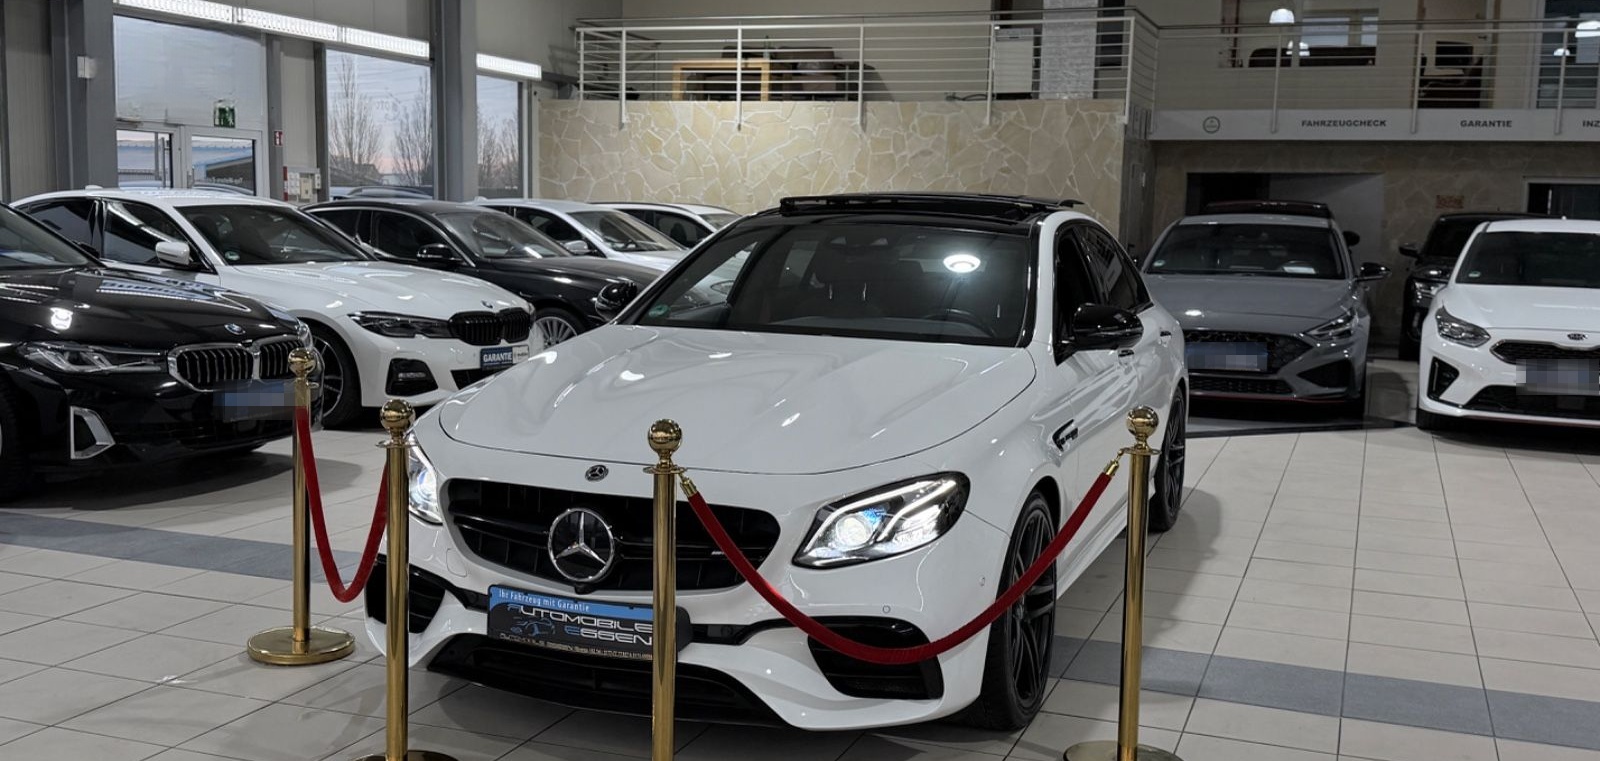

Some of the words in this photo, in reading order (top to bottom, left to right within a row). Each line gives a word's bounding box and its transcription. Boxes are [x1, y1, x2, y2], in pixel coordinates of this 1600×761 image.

[1301, 119, 1387, 128] FAHRZEUGCHECK
[1460, 119, 1513, 128] GARANTIE
[483, 351, 513, 363] GARANTIE
[499, 589, 509, 599] Ihr
[510, 591, 541, 606] Fahrzeug
[543, 598, 556, 607] mit
[557, 600, 590, 612] Garantie
[564, 625, 653, 646] ESSEN
